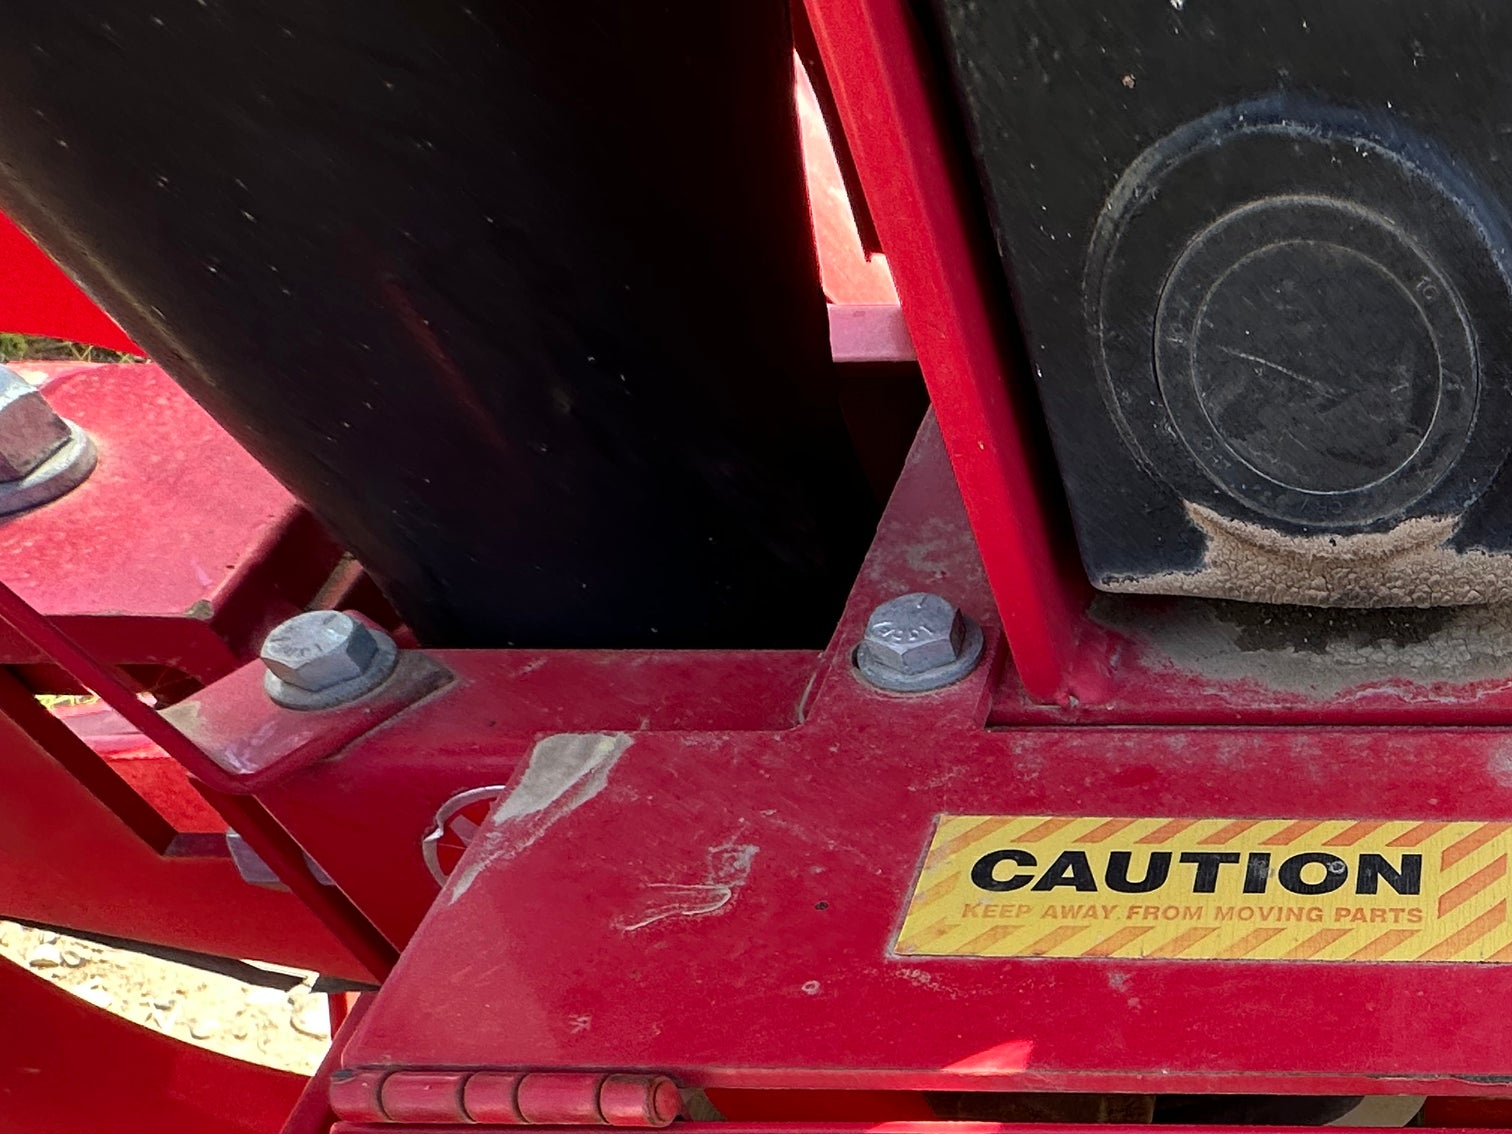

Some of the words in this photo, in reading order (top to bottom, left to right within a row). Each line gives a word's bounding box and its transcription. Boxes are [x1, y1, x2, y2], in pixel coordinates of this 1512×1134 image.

[970, 849, 1422, 896] CAUTION
[962, 903, 1032, 920] KEEP
[1042, 904, 1119, 920] AWAY
[1126, 905, 1207, 921] FROM
[1214, 906, 1324, 922] MOVING
[1334, 907, 1423, 924] PARTS
